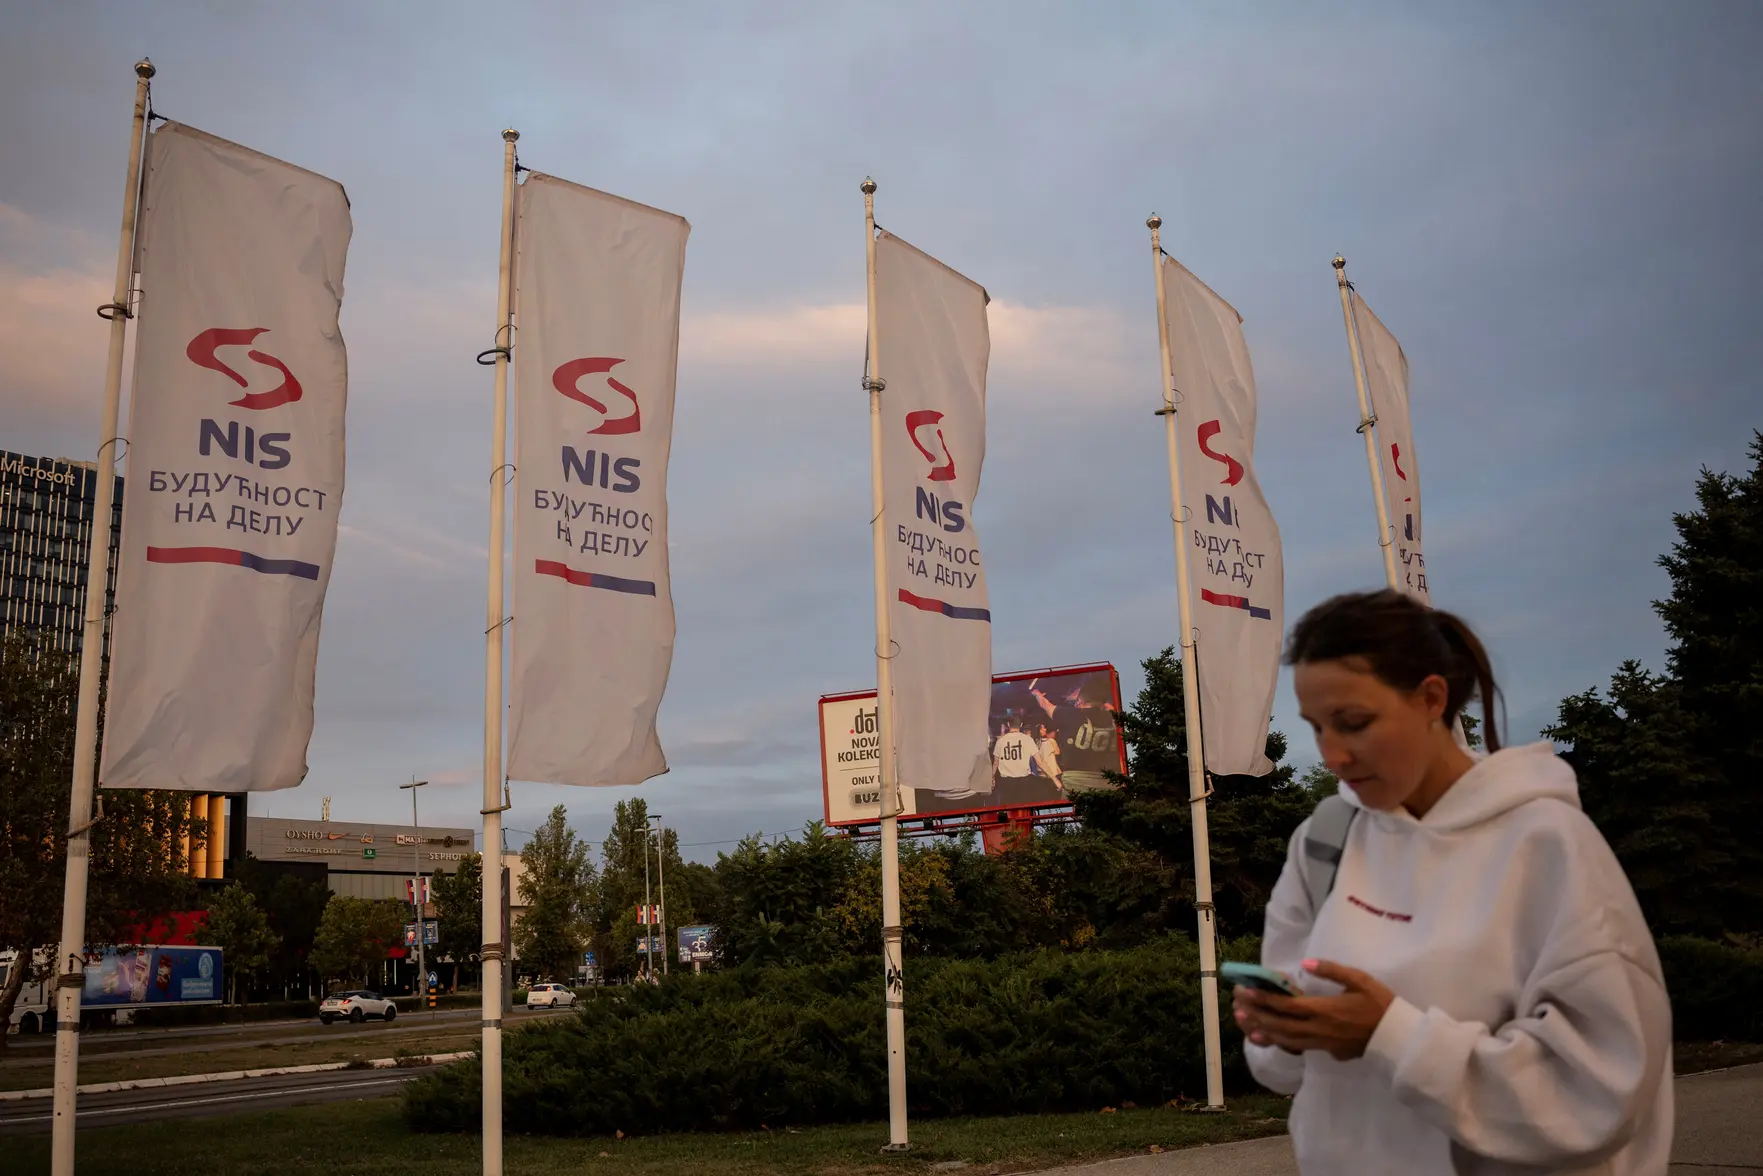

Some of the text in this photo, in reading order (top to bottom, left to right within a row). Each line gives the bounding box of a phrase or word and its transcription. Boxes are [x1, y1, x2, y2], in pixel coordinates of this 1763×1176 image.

[199, 418, 291, 469] NIS
[0, 456, 76, 486] Microsoft
[562, 445, 641, 493] NIS
[149, 470, 327, 511] БУДУЋНОСТ
[174, 502, 304, 536] НА ДЕЛУ
[916, 485, 966, 533] NIS
[580, 530, 648, 558] ДЕЛУ
[897, 524, 980, 566] БУДУЋНОС
[907, 555, 977, 589] НА ДЕЛУ
[1206, 556, 1229, 577] НА
[1000, 739, 1023, 761] .dot
[852, 775, 875, 786] ONLY
[854, 792, 880, 804] BUZ
[286, 829, 323, 840] OYSHO
